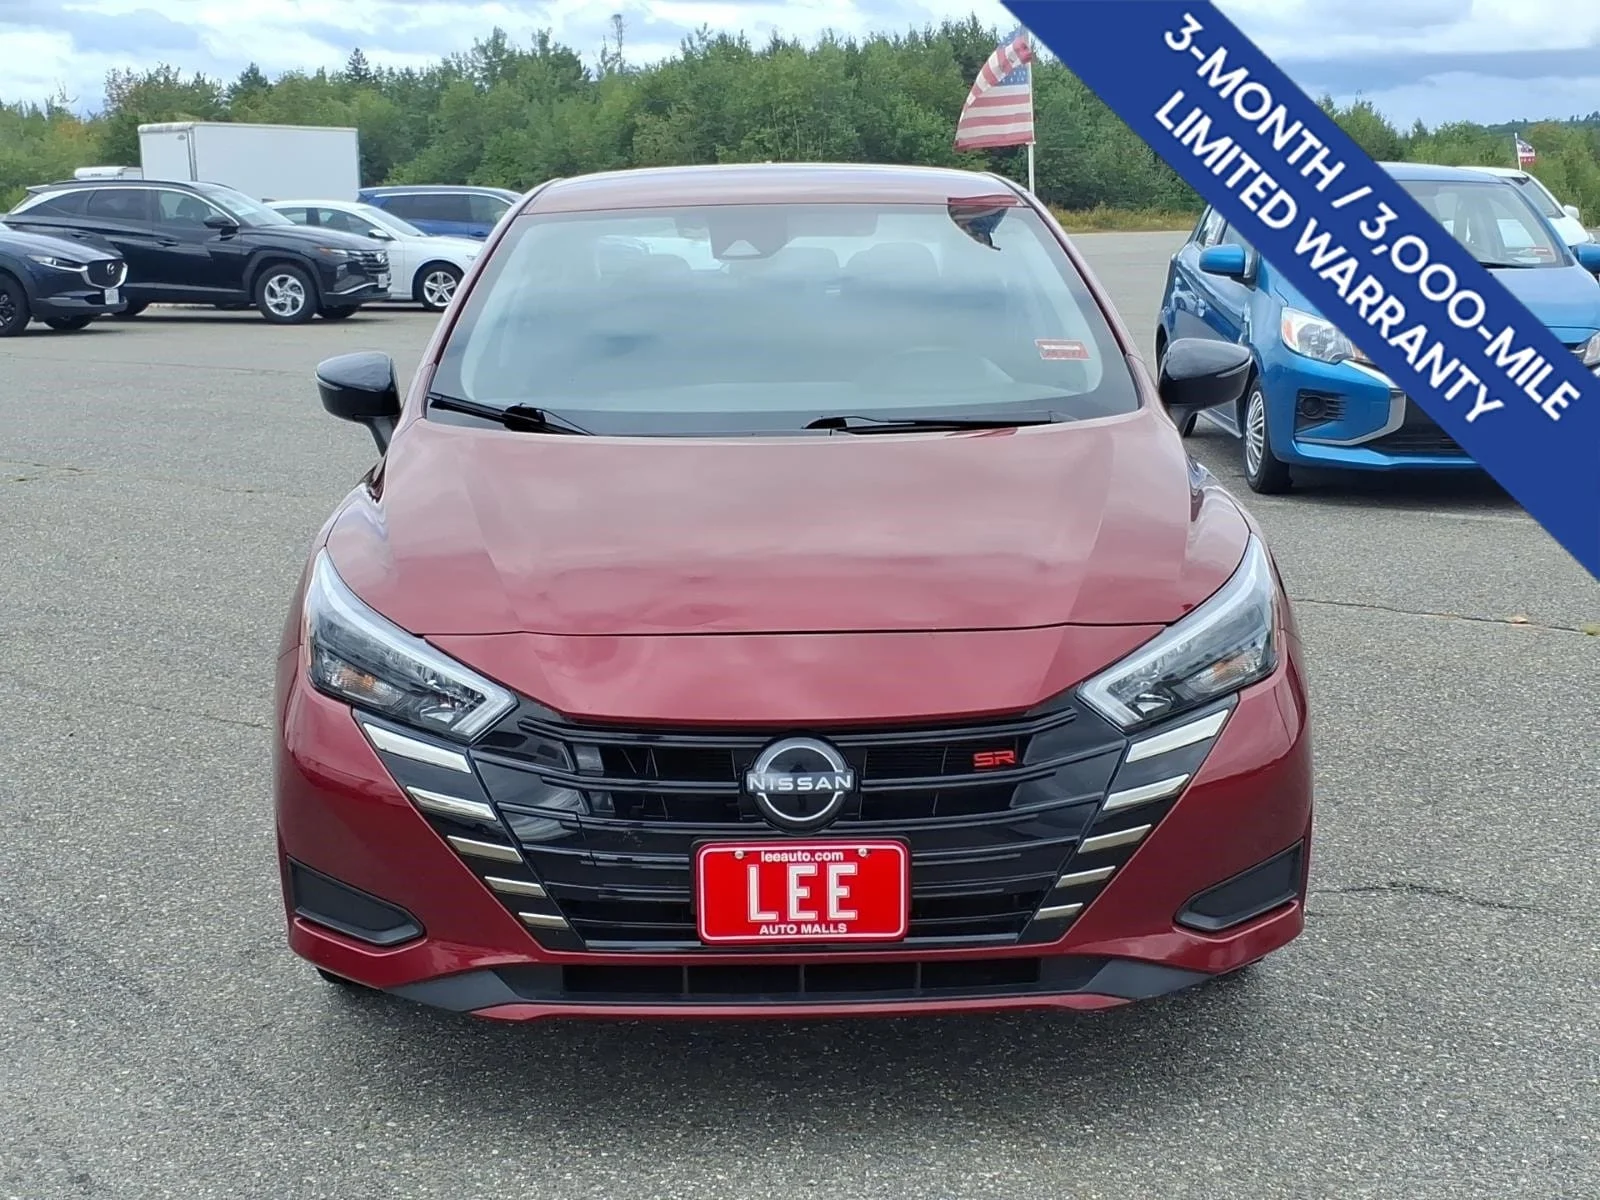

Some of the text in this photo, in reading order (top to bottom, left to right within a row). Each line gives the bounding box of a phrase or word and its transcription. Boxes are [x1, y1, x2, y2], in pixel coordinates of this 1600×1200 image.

[973, 750, 1016, 767] SR
[747, 774, 852, 792] NISSAN
[760, 850, 844, 863] leeauto.com
[747, 862, 858, 922] LEE
[759, 922, 847, 935] AUTO MALLS
